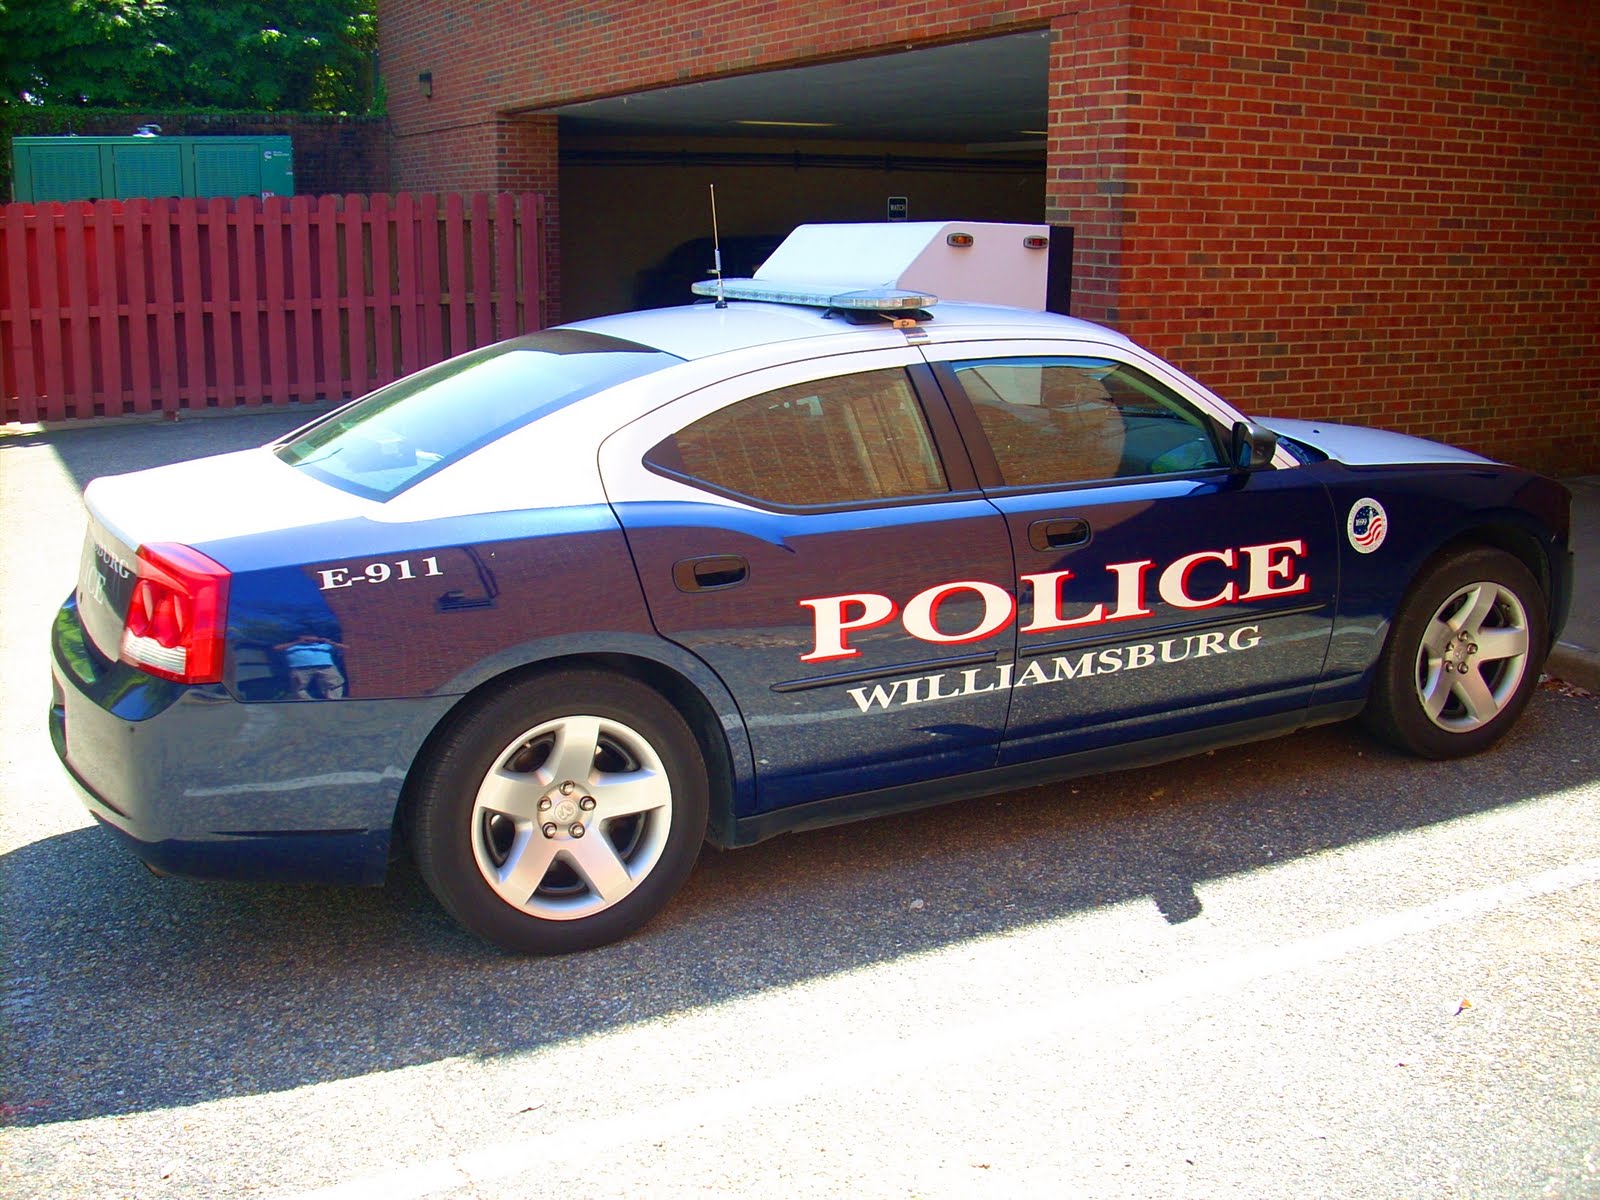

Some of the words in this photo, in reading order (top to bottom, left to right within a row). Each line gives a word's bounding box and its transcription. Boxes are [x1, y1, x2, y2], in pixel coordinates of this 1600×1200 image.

[93, 543, 130, 579] BURG
[316, 556, 444, 591] E-911
[800, 540, 1308, 663] POLICE
[846, 625, 1262, 713] WILLIAMSBURG
